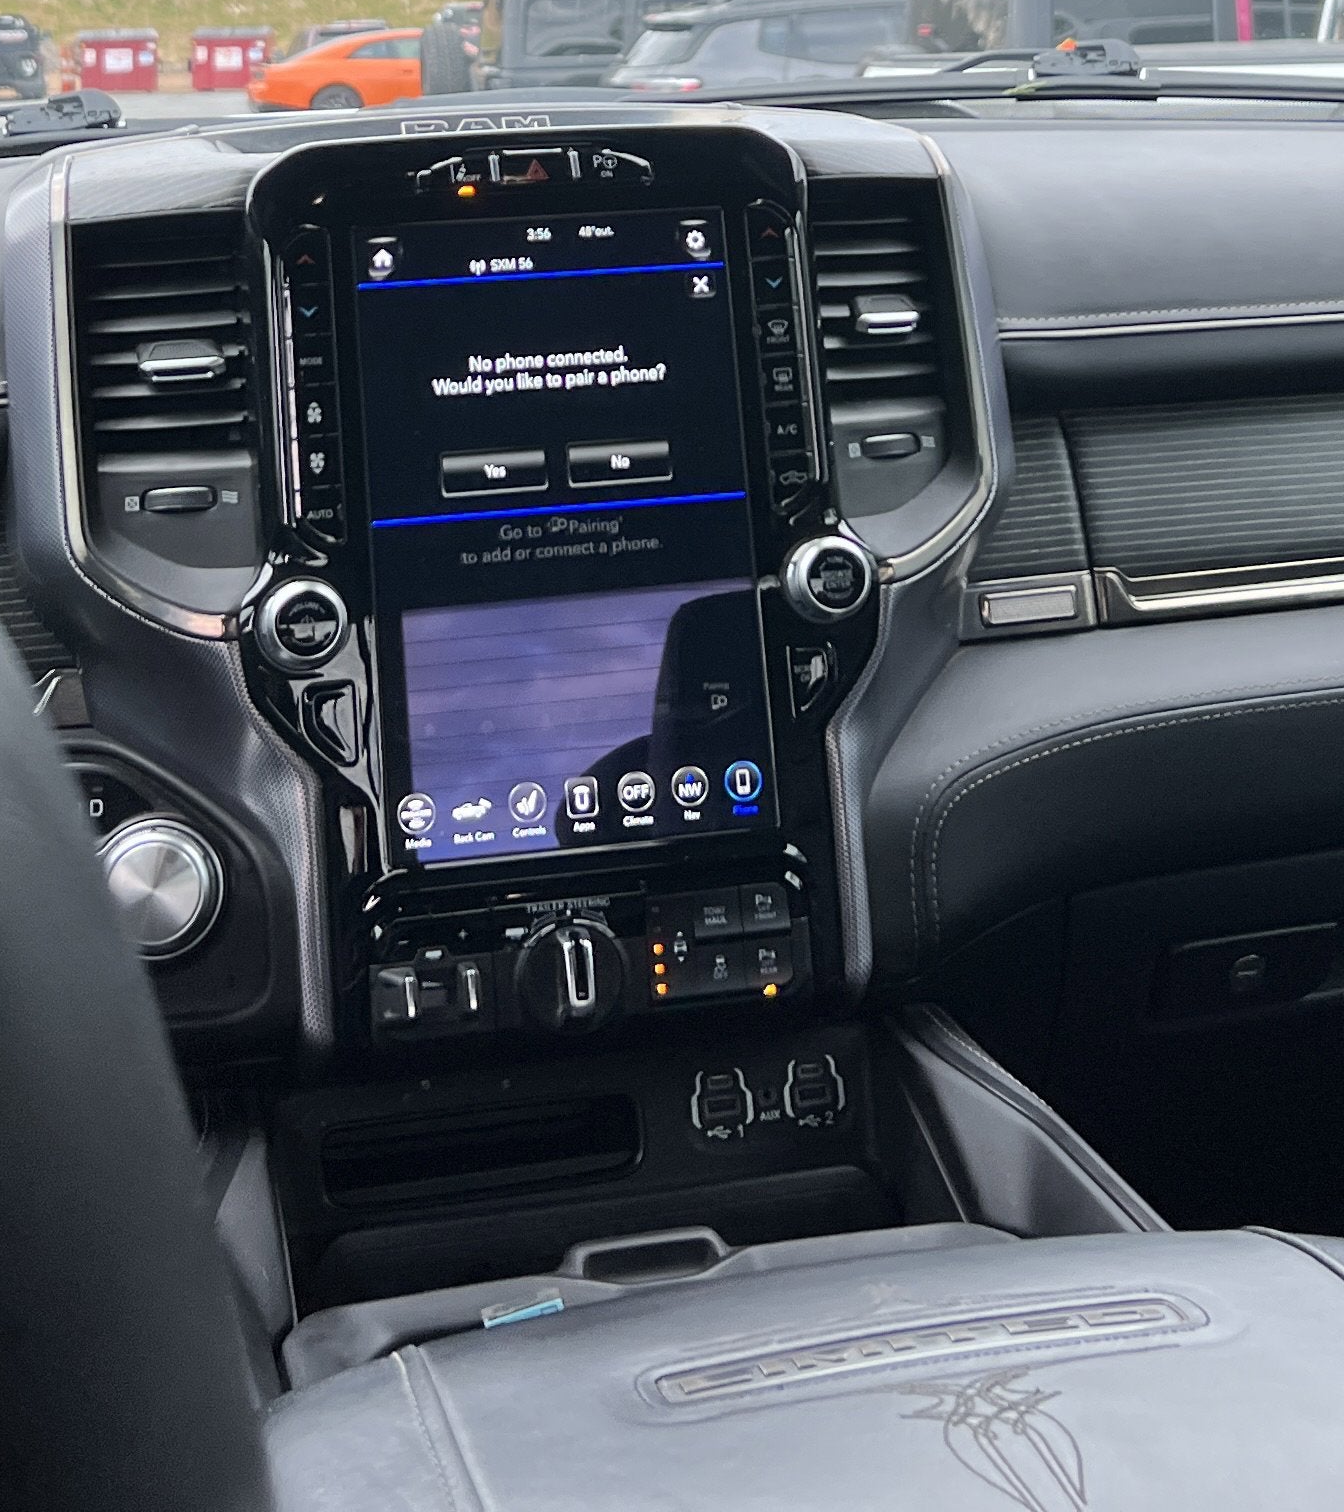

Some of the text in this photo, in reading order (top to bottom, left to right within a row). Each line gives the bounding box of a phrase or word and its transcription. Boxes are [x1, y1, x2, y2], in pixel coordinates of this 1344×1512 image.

[400, 115, 552, 136] RAM
[526, 227, 552, 242] 3:56
[490, 256, 534, 271] SXM 56
[299, 356, 324, 366] MODE
[468, 345, 629, 373] No phone connected.
[431, 362, 667, 396] Would you like to pair a phone?
[776, 423, 798, 436] A/C
[610, 454, 631, 470] No
[483, 463, 507, 479] Yes
[306, 508, 334, 520] AUTO
[499, 524, 523, 540] Go
[527, 525, 543, 538] to
[460, 551, 478, 565] to
[482, 547, 512, 563] add
[514, 548, 532, 561] or
[535, 541, 595, 559] connect
[598, 542, 608, 554] a
[622, 783, 651, 802] OFF
[678, 781, 703, 798] NW
[89, 799, 104, 818] D
[683, 809, 701, 821] Nav
[573, 821, 596, 833] Apps
[622, 814, 654, 828] Climate
[453, 830, 496, 845] Back Cam
[512, 825, 547, 838] Controls
[405, 838, 433, 851] Media
[759, 1109, 781, 1122] AUX
[824, 1110, 834, 1125] 2
[677, 1305, 1167, 1396] LIMITED
